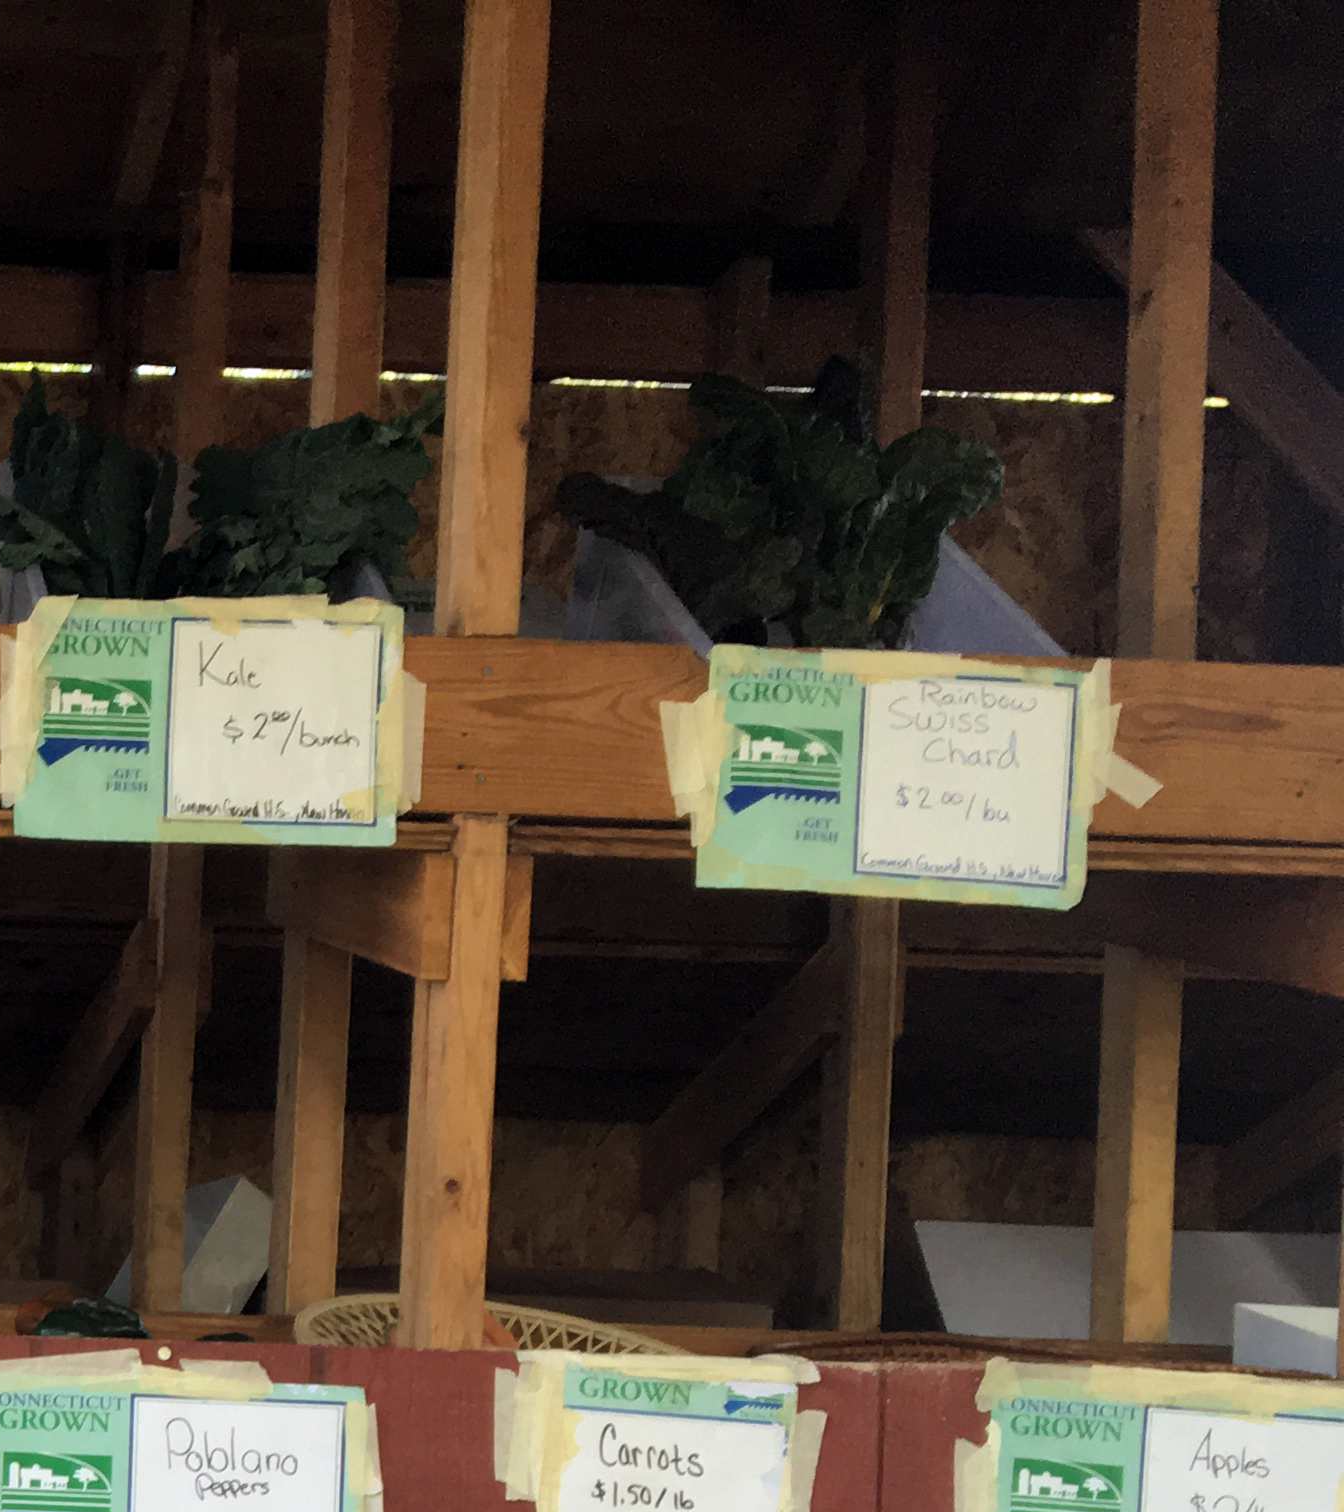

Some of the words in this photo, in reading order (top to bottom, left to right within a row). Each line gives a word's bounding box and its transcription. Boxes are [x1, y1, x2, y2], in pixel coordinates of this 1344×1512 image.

[198, 640, 262, 690] Kale
[728, 680, 843, 709] GROWN
[918, 680, 1039, 713] Rainbow
[887, 697, 991, 735] Swiss
[921, 733, 1021, 771] Chard
[579, 1376, 692, 1405] GROWN
[0, 1408, 111, 1432] GROWN
[1010, 1413, 1123, 1442] GROWN
[164, 1416, 298, 1476] Poblano
[599, 1423, 705, 1478] Carrots
[1189, 1428, 1271, 1479] Apples
[195, 1473, 272, 1502] Peppers
